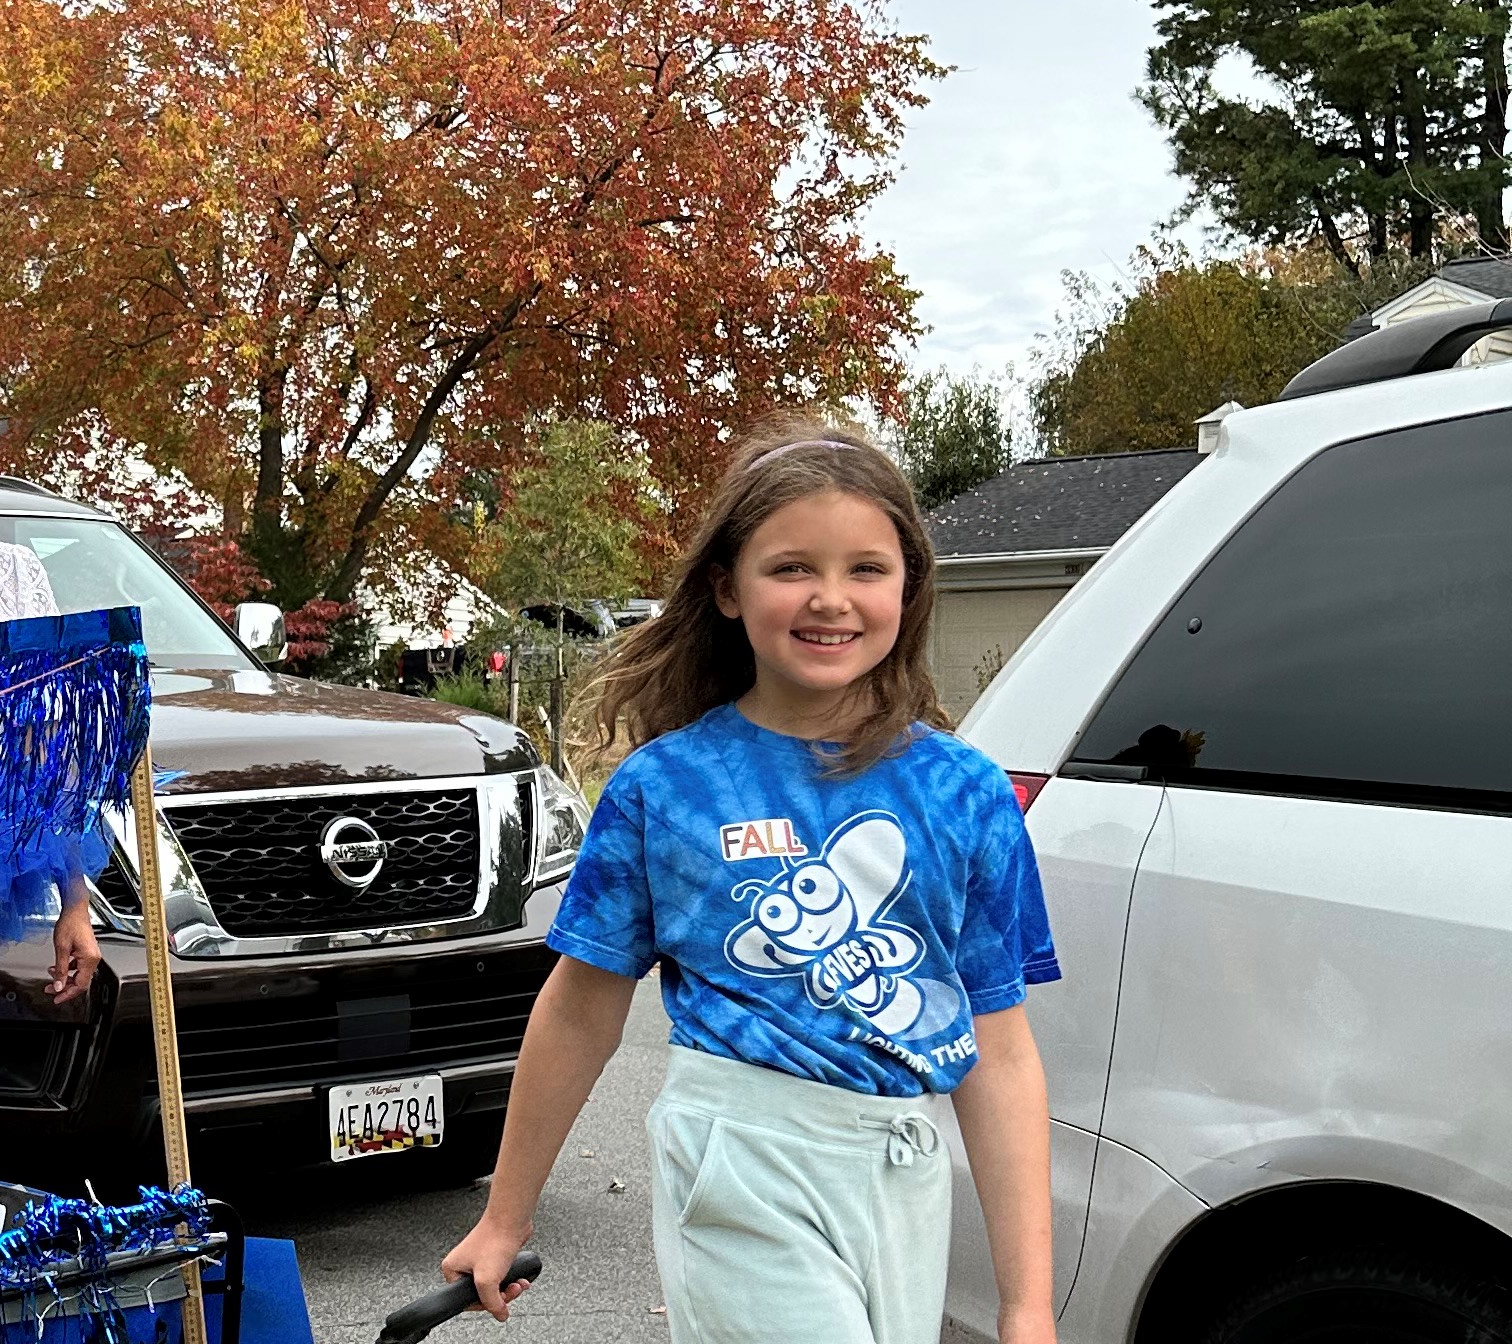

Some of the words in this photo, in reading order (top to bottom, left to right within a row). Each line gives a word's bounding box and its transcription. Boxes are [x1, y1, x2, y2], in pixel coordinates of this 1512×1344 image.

[332, 844, 386, 859] NISSAN
[723, 821, 804, 859] FALL
[930, 1032, 977, 1067] THE
[365, 1083, 403, 1097] Maryland
[337, 1095, 436, 1147] 4EA2784
